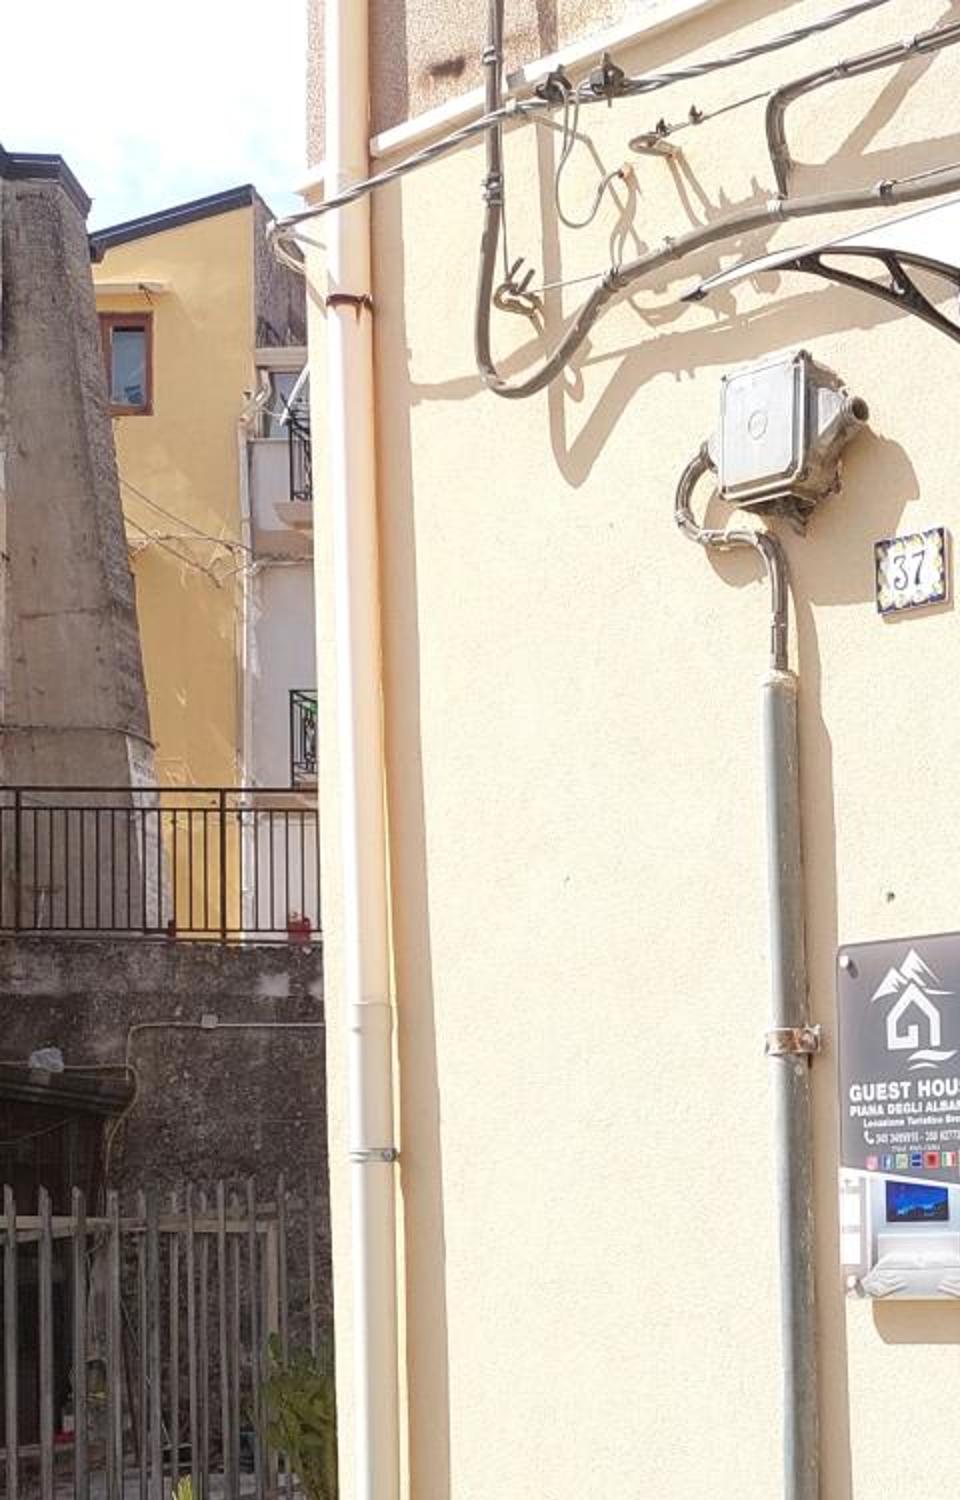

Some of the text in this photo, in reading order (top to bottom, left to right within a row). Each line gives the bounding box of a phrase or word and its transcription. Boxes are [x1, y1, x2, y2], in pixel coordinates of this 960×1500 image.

[894, 550, 925, 591] 37
[850, 1082, 911, 1101] GUEST
[850, 1104, 884, 1116] PIANA
[887, 1102, 922, 1114] DEGLI
